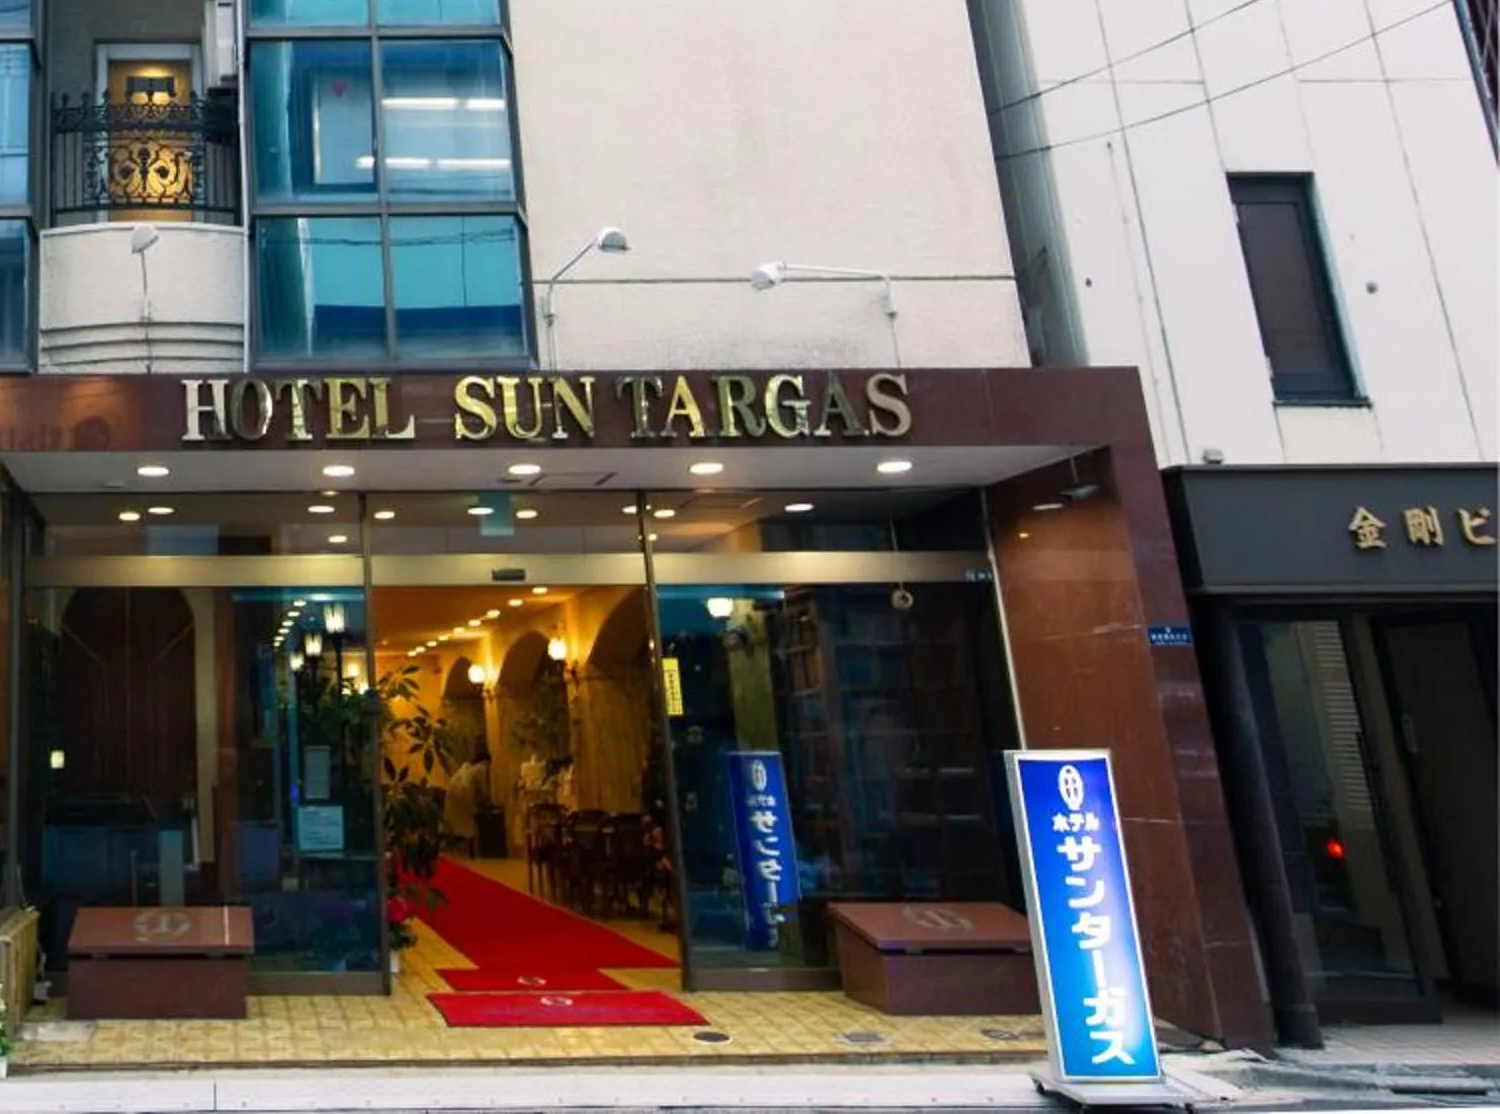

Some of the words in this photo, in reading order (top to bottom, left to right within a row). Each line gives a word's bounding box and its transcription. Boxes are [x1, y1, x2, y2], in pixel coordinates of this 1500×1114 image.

[181, 378, 416, 443] HOTEL
[453, 375, 596, 443] SUN
[616, 372, 912, 439] TARGAS
[1348, 505, 1496, 547] 金剛ビ
[1051, 812, 1100, 833] ホテル
[1056, 836, 1136, 1065] サンターガス
